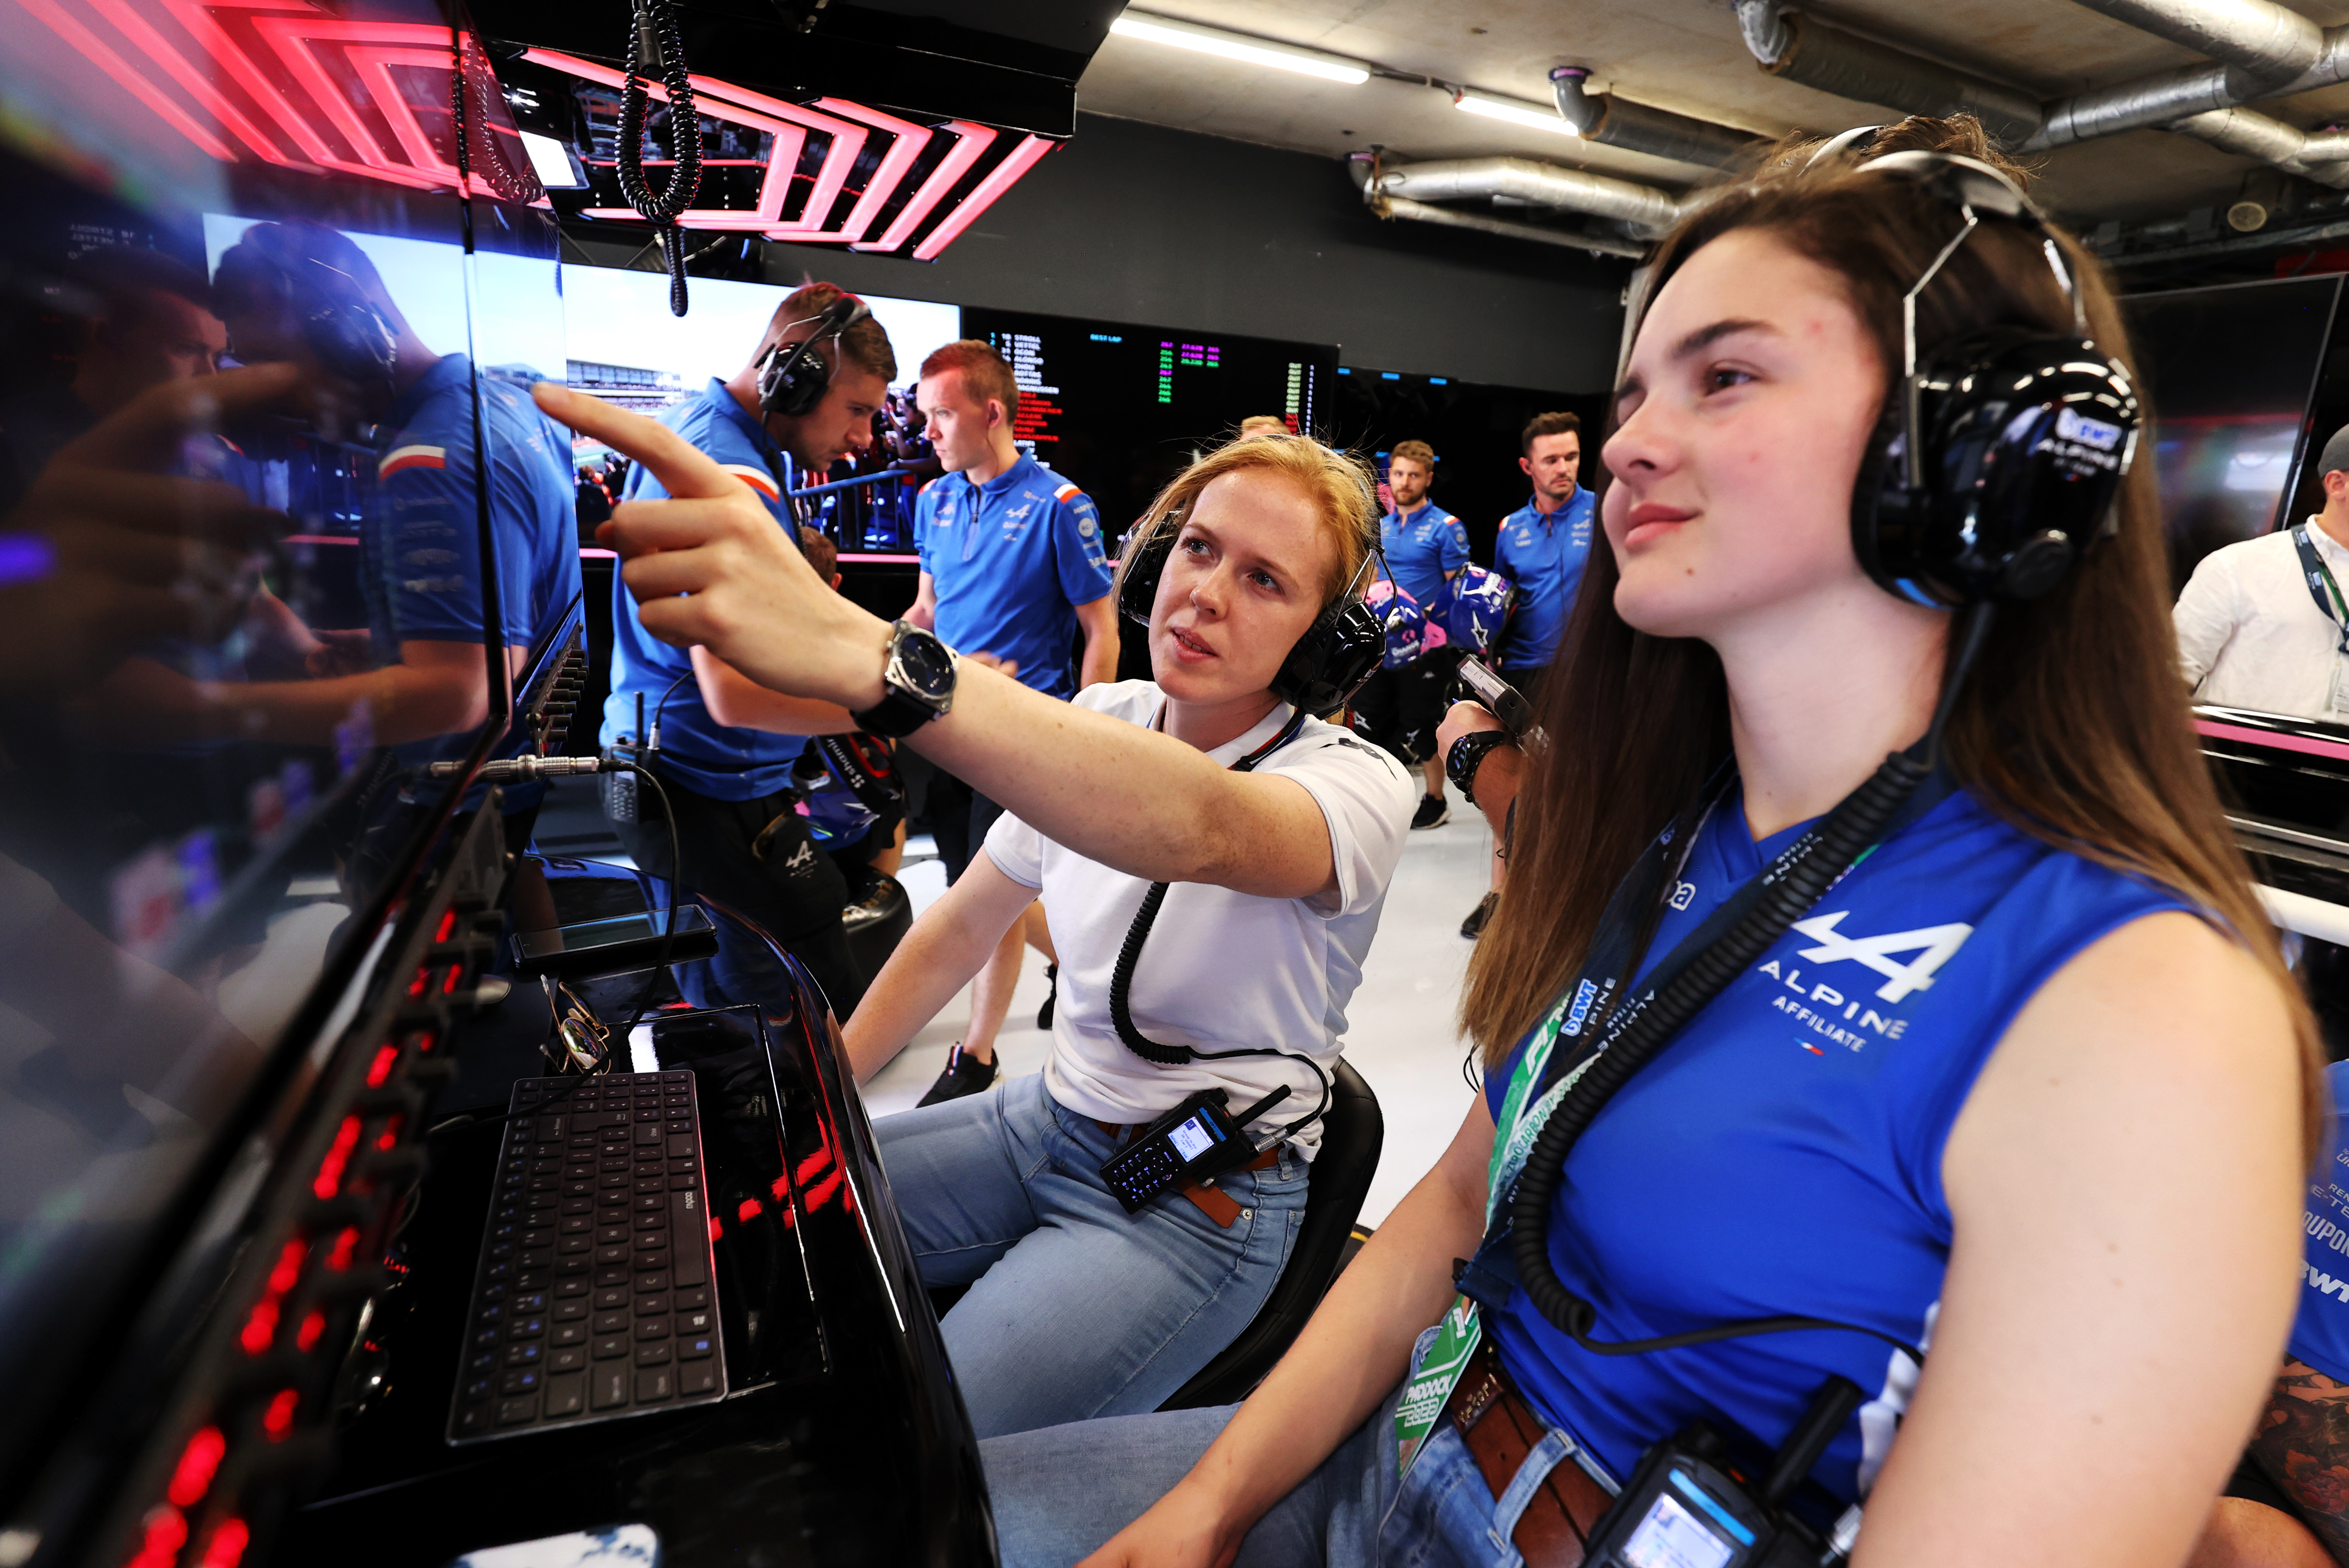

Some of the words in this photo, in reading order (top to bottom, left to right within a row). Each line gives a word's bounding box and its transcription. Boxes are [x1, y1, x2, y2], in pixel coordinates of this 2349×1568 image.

[1014, 334, 1041, 344] STROLL
[1014, 341, 1041, 351] VETTEL
[1014, 348, 1036, 357] OCON
[1014, 356, 1044, 366] ALONSO
[1014, 363, 1035, 371] ZHOU
[1014, 369, 1042, 379] BOTTAS
[2035, 438, 2119, 471] ALPINE
[826, 738, 856, 775] shamir
[1569, 978, 1598, 1022] BWT
[1758, 960, 1909, 1040] ALPINE
[1597, 989, 1654, 1050] ALPINE
[1606, 1008, 1627, 1029] TEAM
[1772, 995, 1867, 1052] AFFILIATE
[1506, 1145, 1524, 1172] ZERO
[1519, 1108, 1548, 1149] CARBON
[685, 1192, 695, 1209] rapoo
[1405, 1374, 1453, 1404] PADDOCK
[1400, 1397, 1440, 1428] 2022
